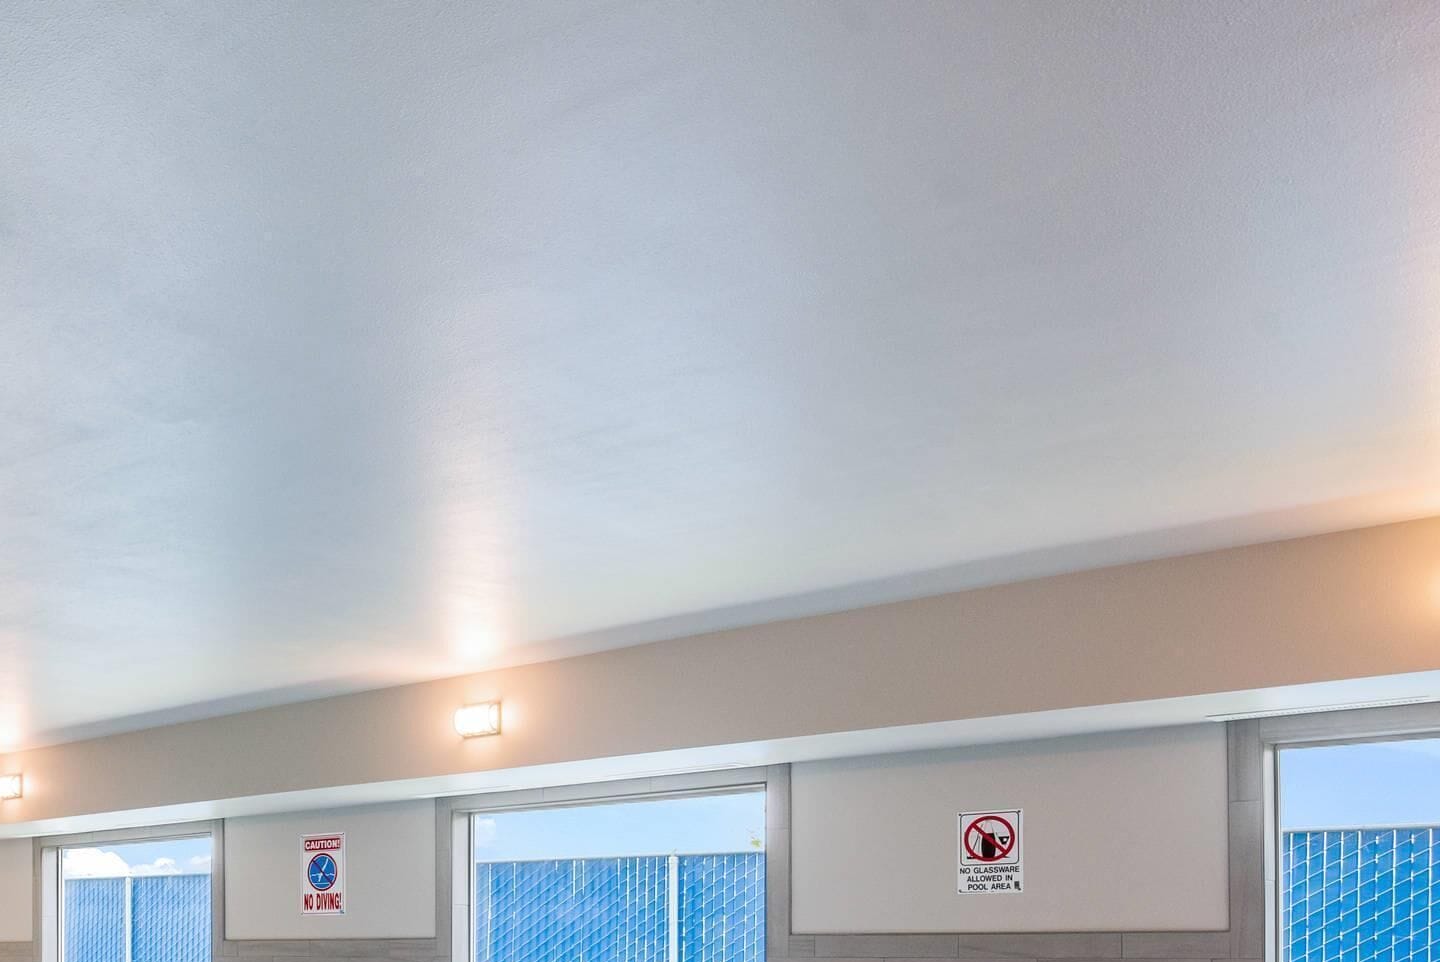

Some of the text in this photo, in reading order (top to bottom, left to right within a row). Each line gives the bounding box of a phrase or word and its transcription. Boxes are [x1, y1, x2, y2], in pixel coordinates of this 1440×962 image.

[305, 839, 341, 850] CAUTION!
[960, 865, 1020, 875] NO GLASSWARE
[967, 874, 1003, 883] ALLOWED
[967, 882, 1011, 891] POOL AREA
[304, 891, 342, 911] NO DIVING!
